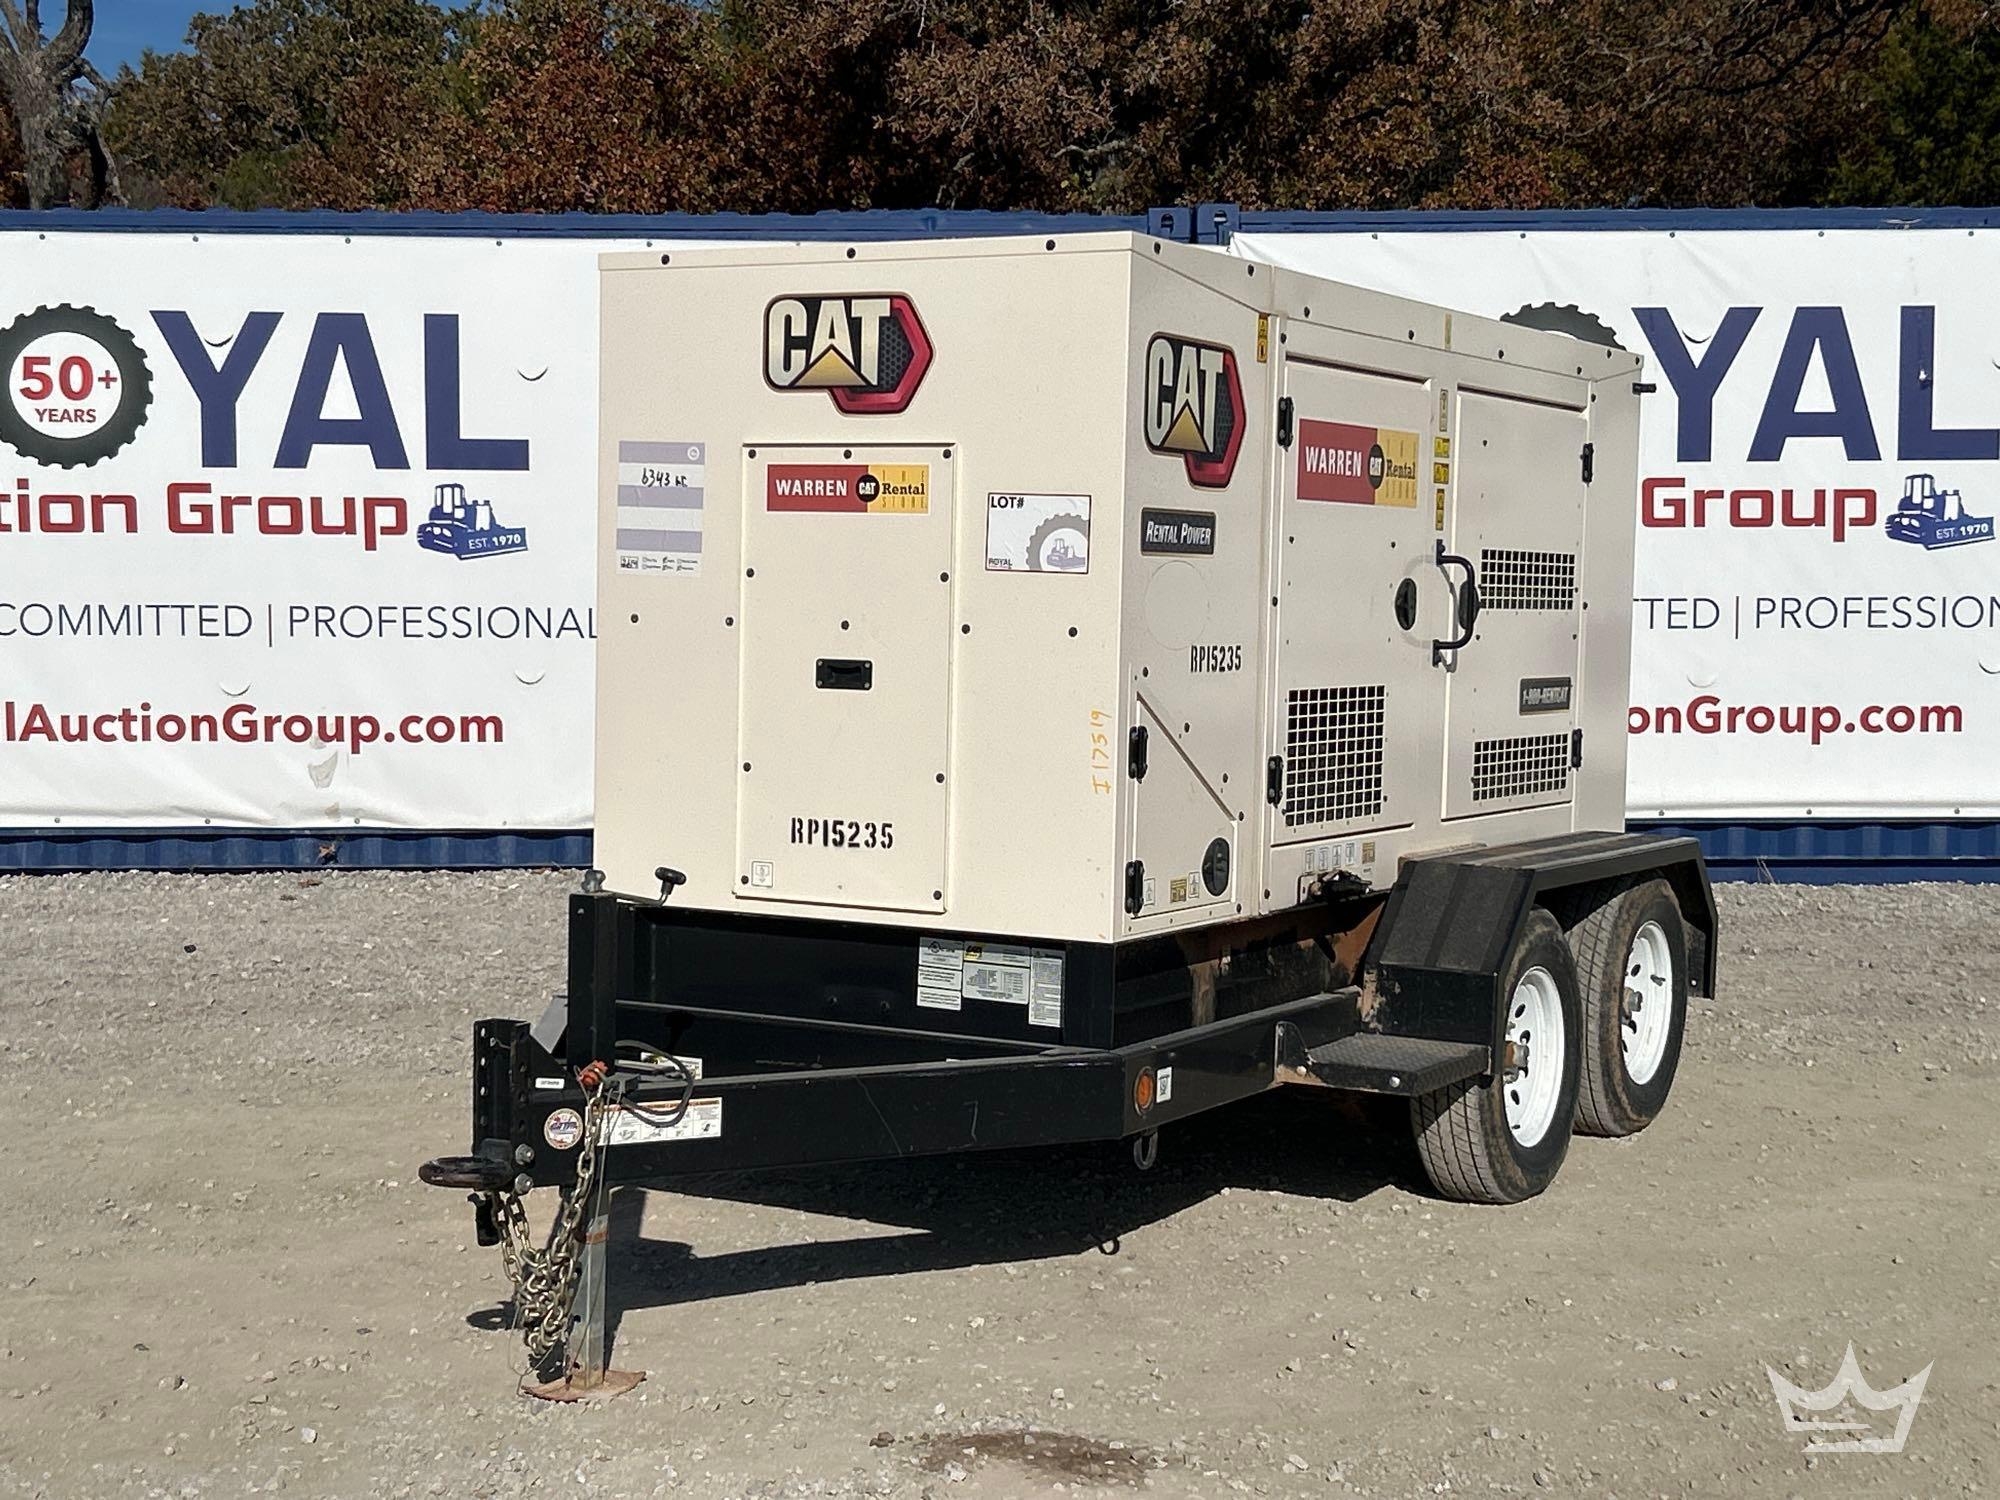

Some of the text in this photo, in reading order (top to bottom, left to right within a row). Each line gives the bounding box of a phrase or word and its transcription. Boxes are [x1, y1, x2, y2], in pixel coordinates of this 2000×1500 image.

[768, 299, 892, 386] CAT
[20, 355, 118, 402] 50+
[1147, 338, 1224, 453] CAT
[34, 407, 97, 424] YEARS
[641, 467, 671, 488] 6343
[1305, 446, 1363, 478] WARREN
[1386, 457, 1416, 481] Rental
[775, 478, 926, 497] WARREN CAT Rental
[990, 495, 1025, 509] LOT#
[167, 482, 406, 550] Group
[1642, 477, 1876, 542] Group
[492, 533, 522, 547] 1970
[1959, 522, 1990, 537] 1970
[0, 602, 598, 639] COMMITTED PROFESSIONAL
[1633, 597, 1720, 630] TED
[1627, 695, 1964, 745] onGroup.com
